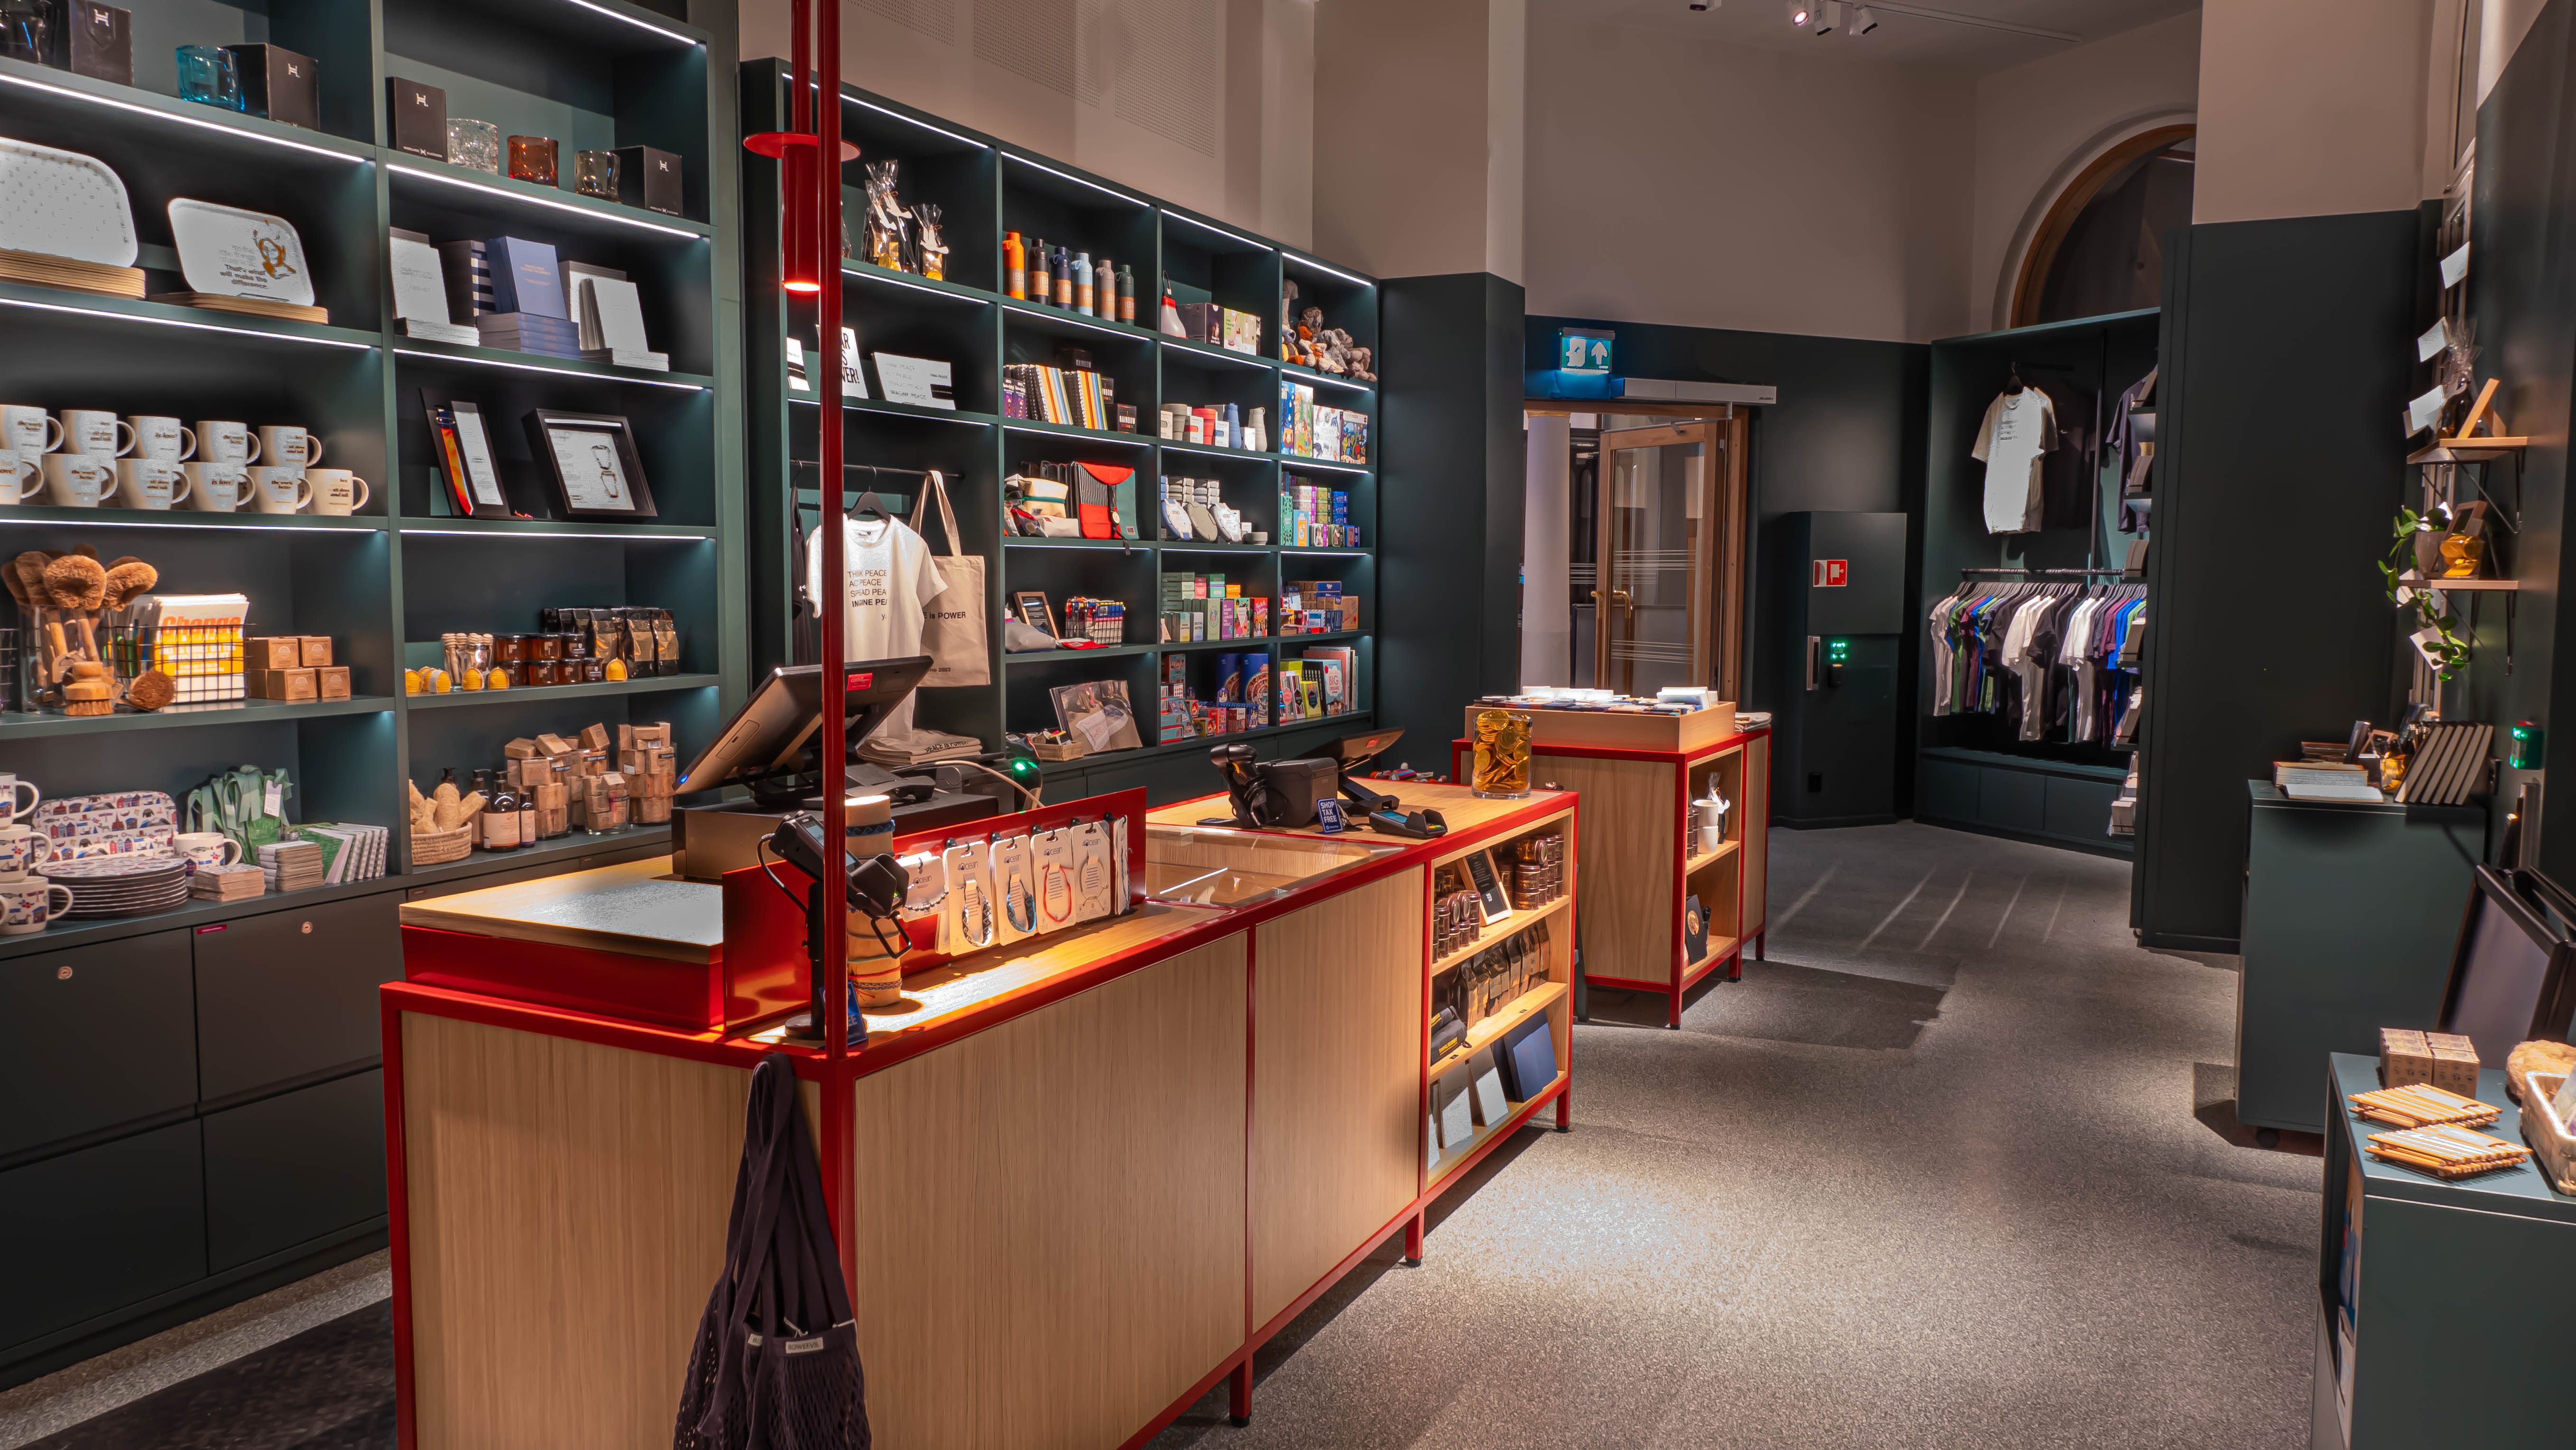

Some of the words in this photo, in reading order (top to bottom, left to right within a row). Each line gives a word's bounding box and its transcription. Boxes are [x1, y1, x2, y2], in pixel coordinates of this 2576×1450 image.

[842, 333, 851, 350] AR
[842, 367, 860, 384] VER!
[1119, 415, 1136, 425] RAINBOW
[938, 611, 966, 620] POWER
[1329, 675, 1339, 686] BIG
[925, 744, 943, 753] PEACE
[1324, 815, 1337, 823] FREE
